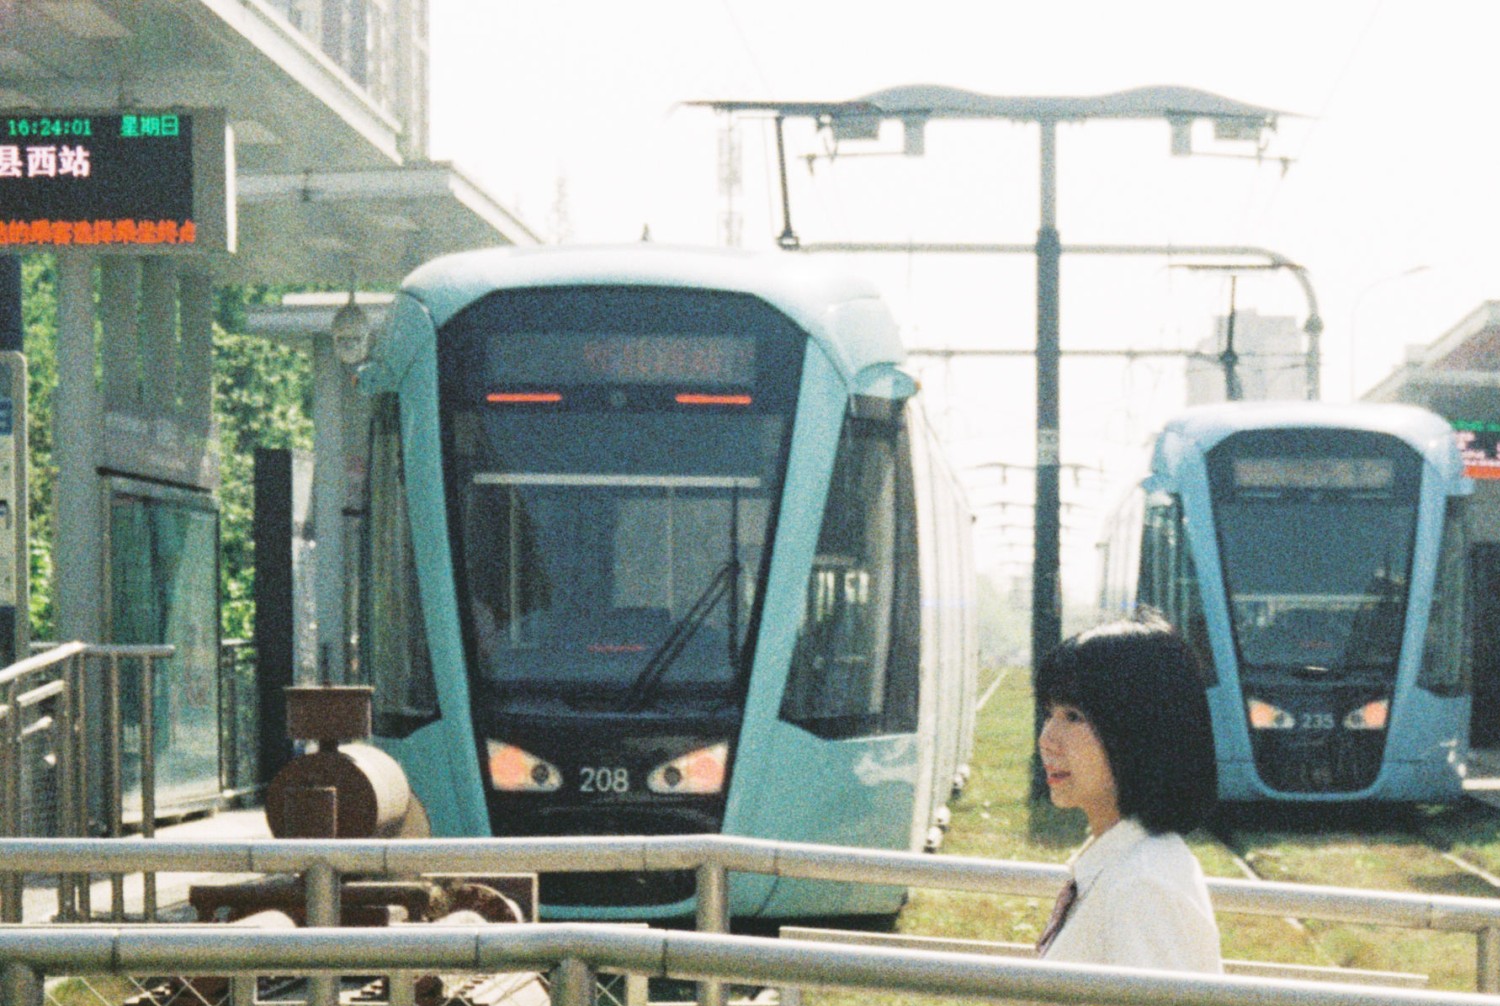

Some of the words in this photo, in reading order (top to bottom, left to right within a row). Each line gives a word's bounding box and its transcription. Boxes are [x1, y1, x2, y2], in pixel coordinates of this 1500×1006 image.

[9, 119, 91, 136] 16:24:01
[120, 115, 179, 137] 星期日
[0, 145, 90, 177] 县西站
[1302, 714, 1334, 729] 235
[580, 766, 629, 793] 208
